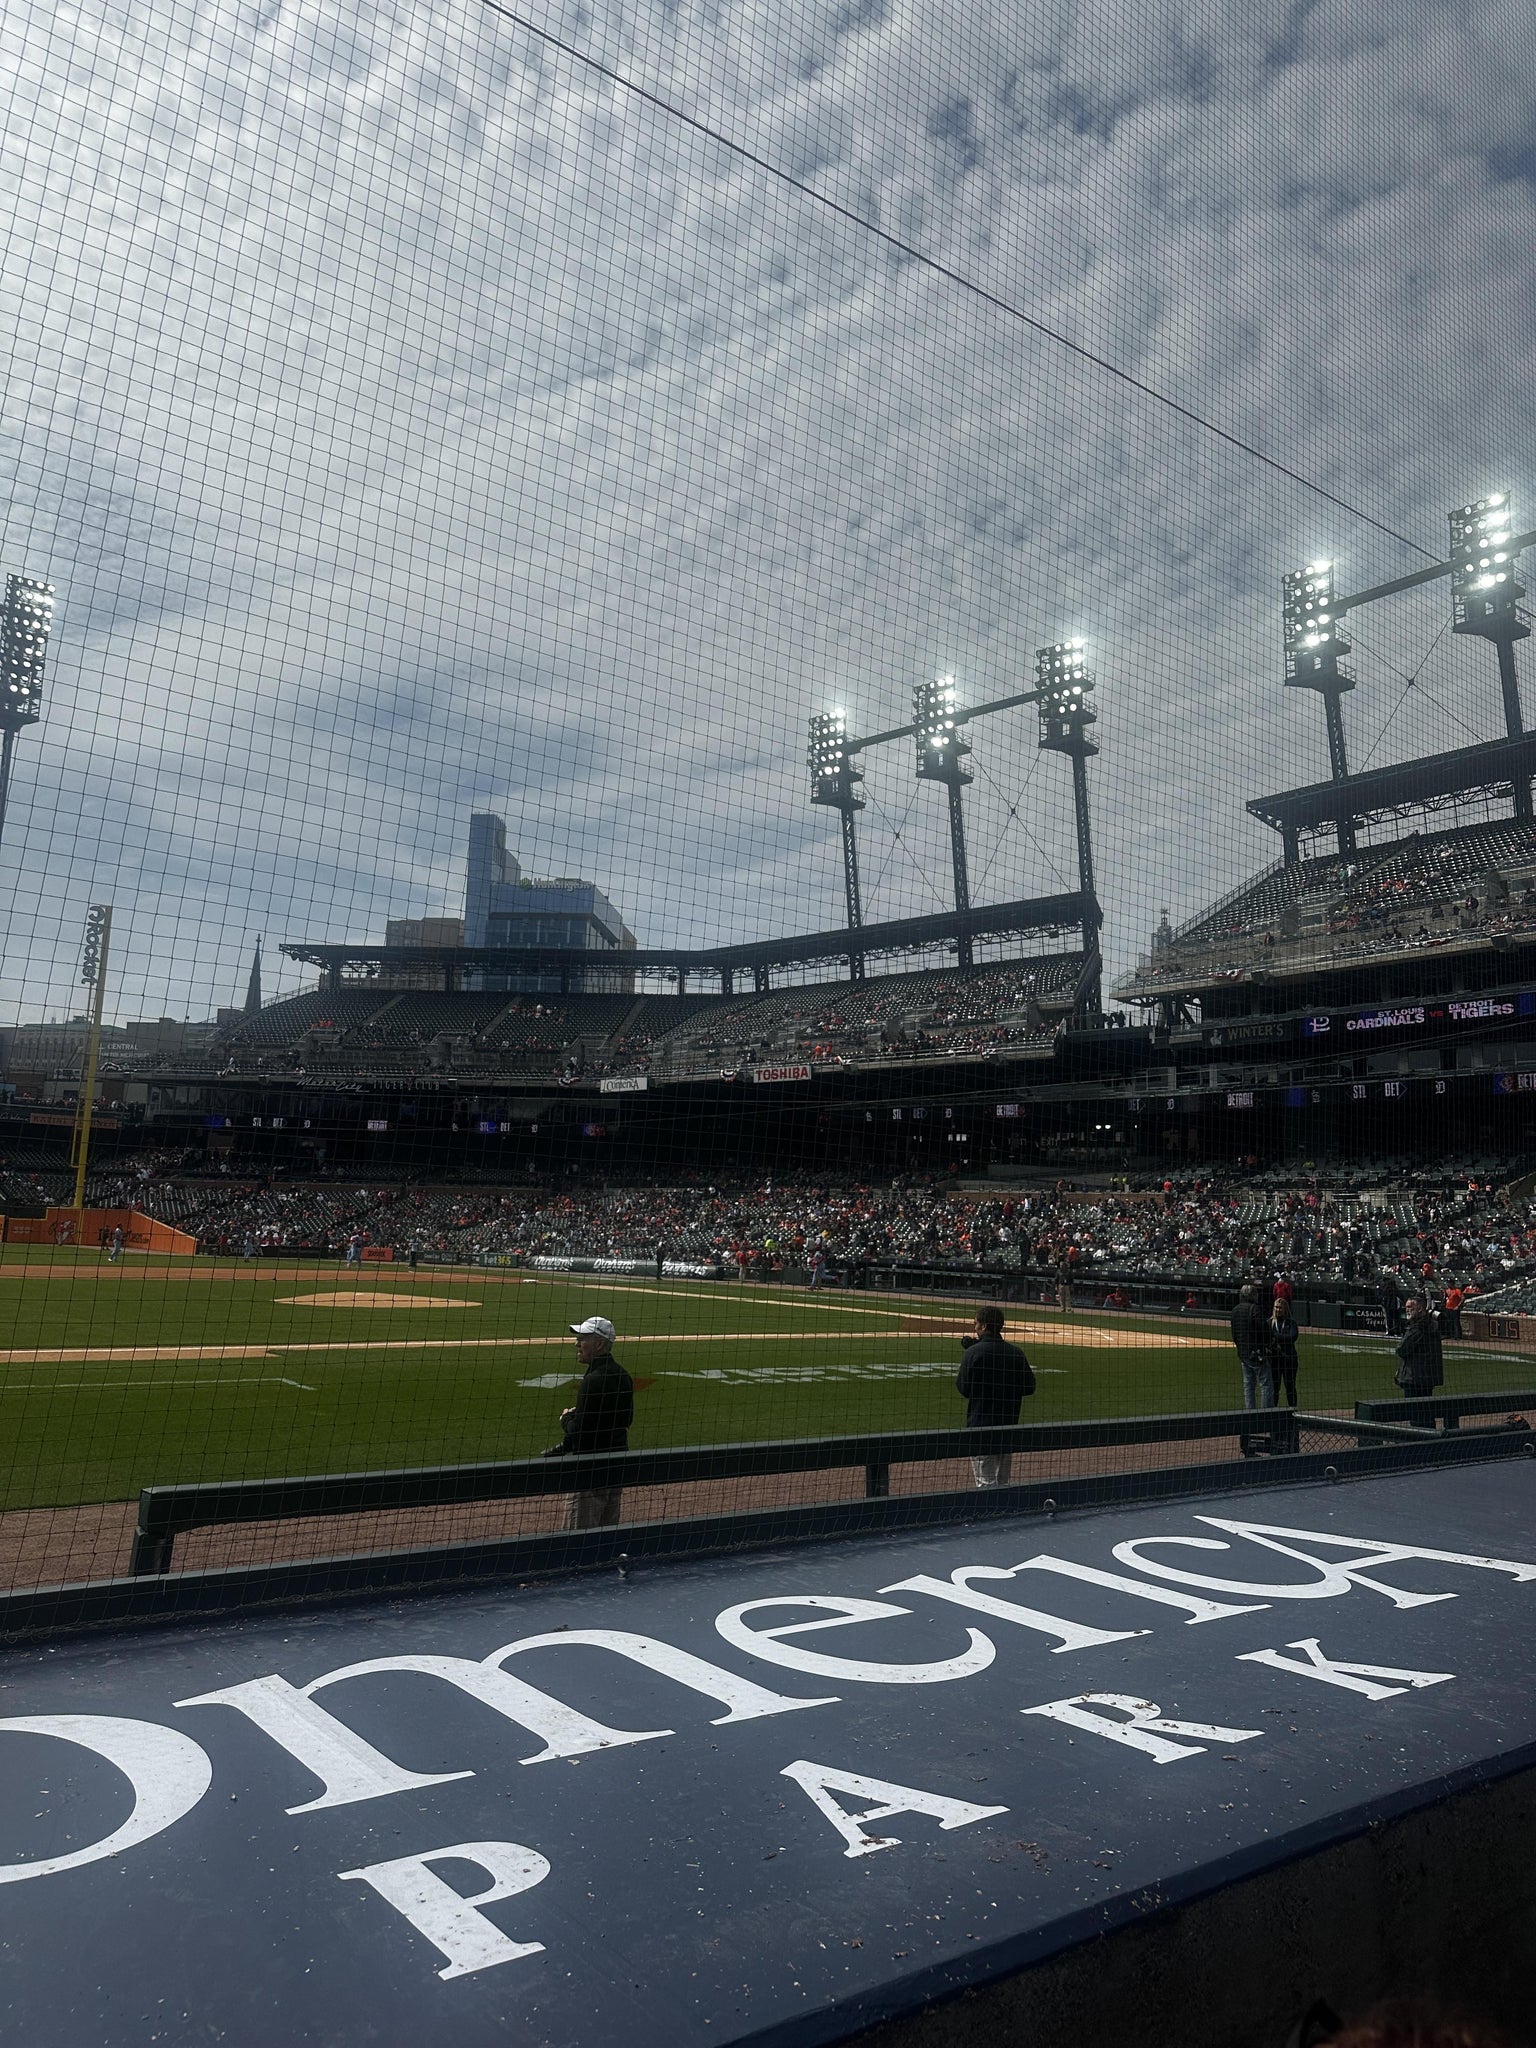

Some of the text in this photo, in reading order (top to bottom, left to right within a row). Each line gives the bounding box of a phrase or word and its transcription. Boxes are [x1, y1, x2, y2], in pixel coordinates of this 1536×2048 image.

[1449, 999, 1495, 1010] DETROIT
[1449, 1003, 1514, 1020] TIGERS
[1346, 1013, 1425, 1030] CARDINALS
[1227, 1024, 1285, 1040] WINTER'S
[756, 1067, 809, 1081] TOSHIBA
[415, 1080, 440, 1090] CLUB
[1384, 1082, 1400, 1097] DET
[653, 1362, 1037, 1379] VICTOR
